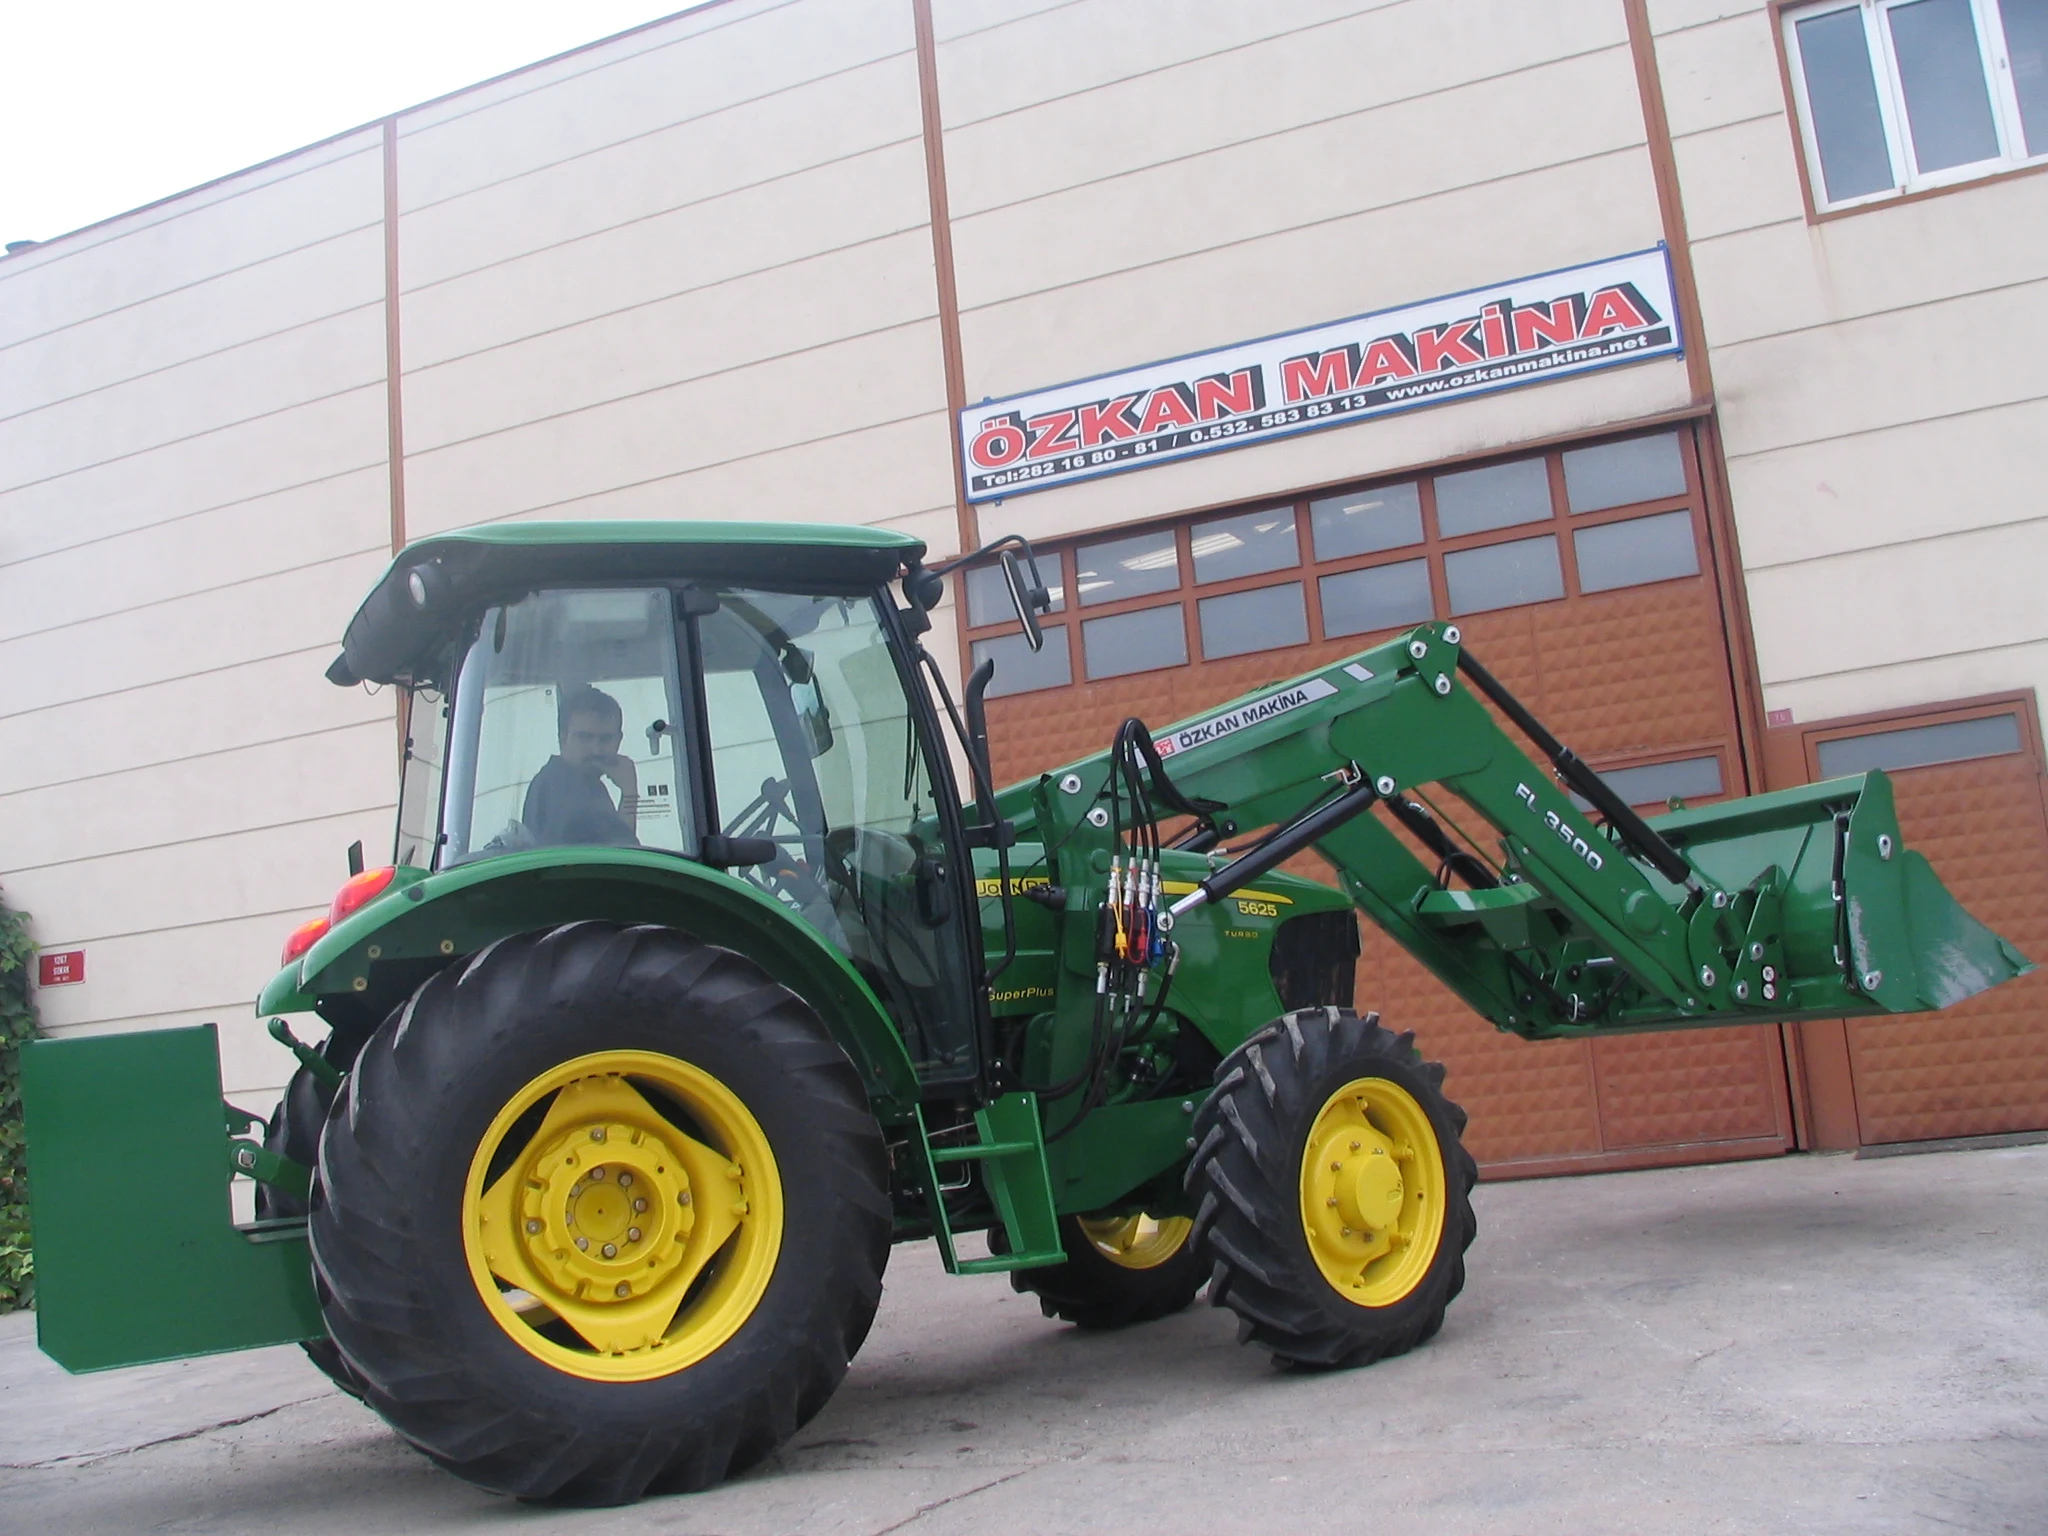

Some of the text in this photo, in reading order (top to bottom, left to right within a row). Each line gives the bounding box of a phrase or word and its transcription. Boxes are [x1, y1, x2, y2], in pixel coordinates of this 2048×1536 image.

[970, 284, 1656, 468] ÖZKAN MAKİNA
[983, 462, 1055, 487] Tel:282
[1062, 456, 1086, 470] 16
[1092, 449, 1116, 464] 80
[1134, 439, 1158, 455] 81
[1261, 409, 1300, 428] 583
[1307, 403, 1333, 418] 83
[1340, 395, 1367, 411] 13
[1386, 334, 1648, 400] www.ozkanmakina.net
[1178, 690, 1309, 748] ÖZKAN MAKİNA
[1514, 782, 1603, 872] FL 3500
[1224, 930, 1259, 939] TURBO
[1237, 901, 1278, 917] 5625
